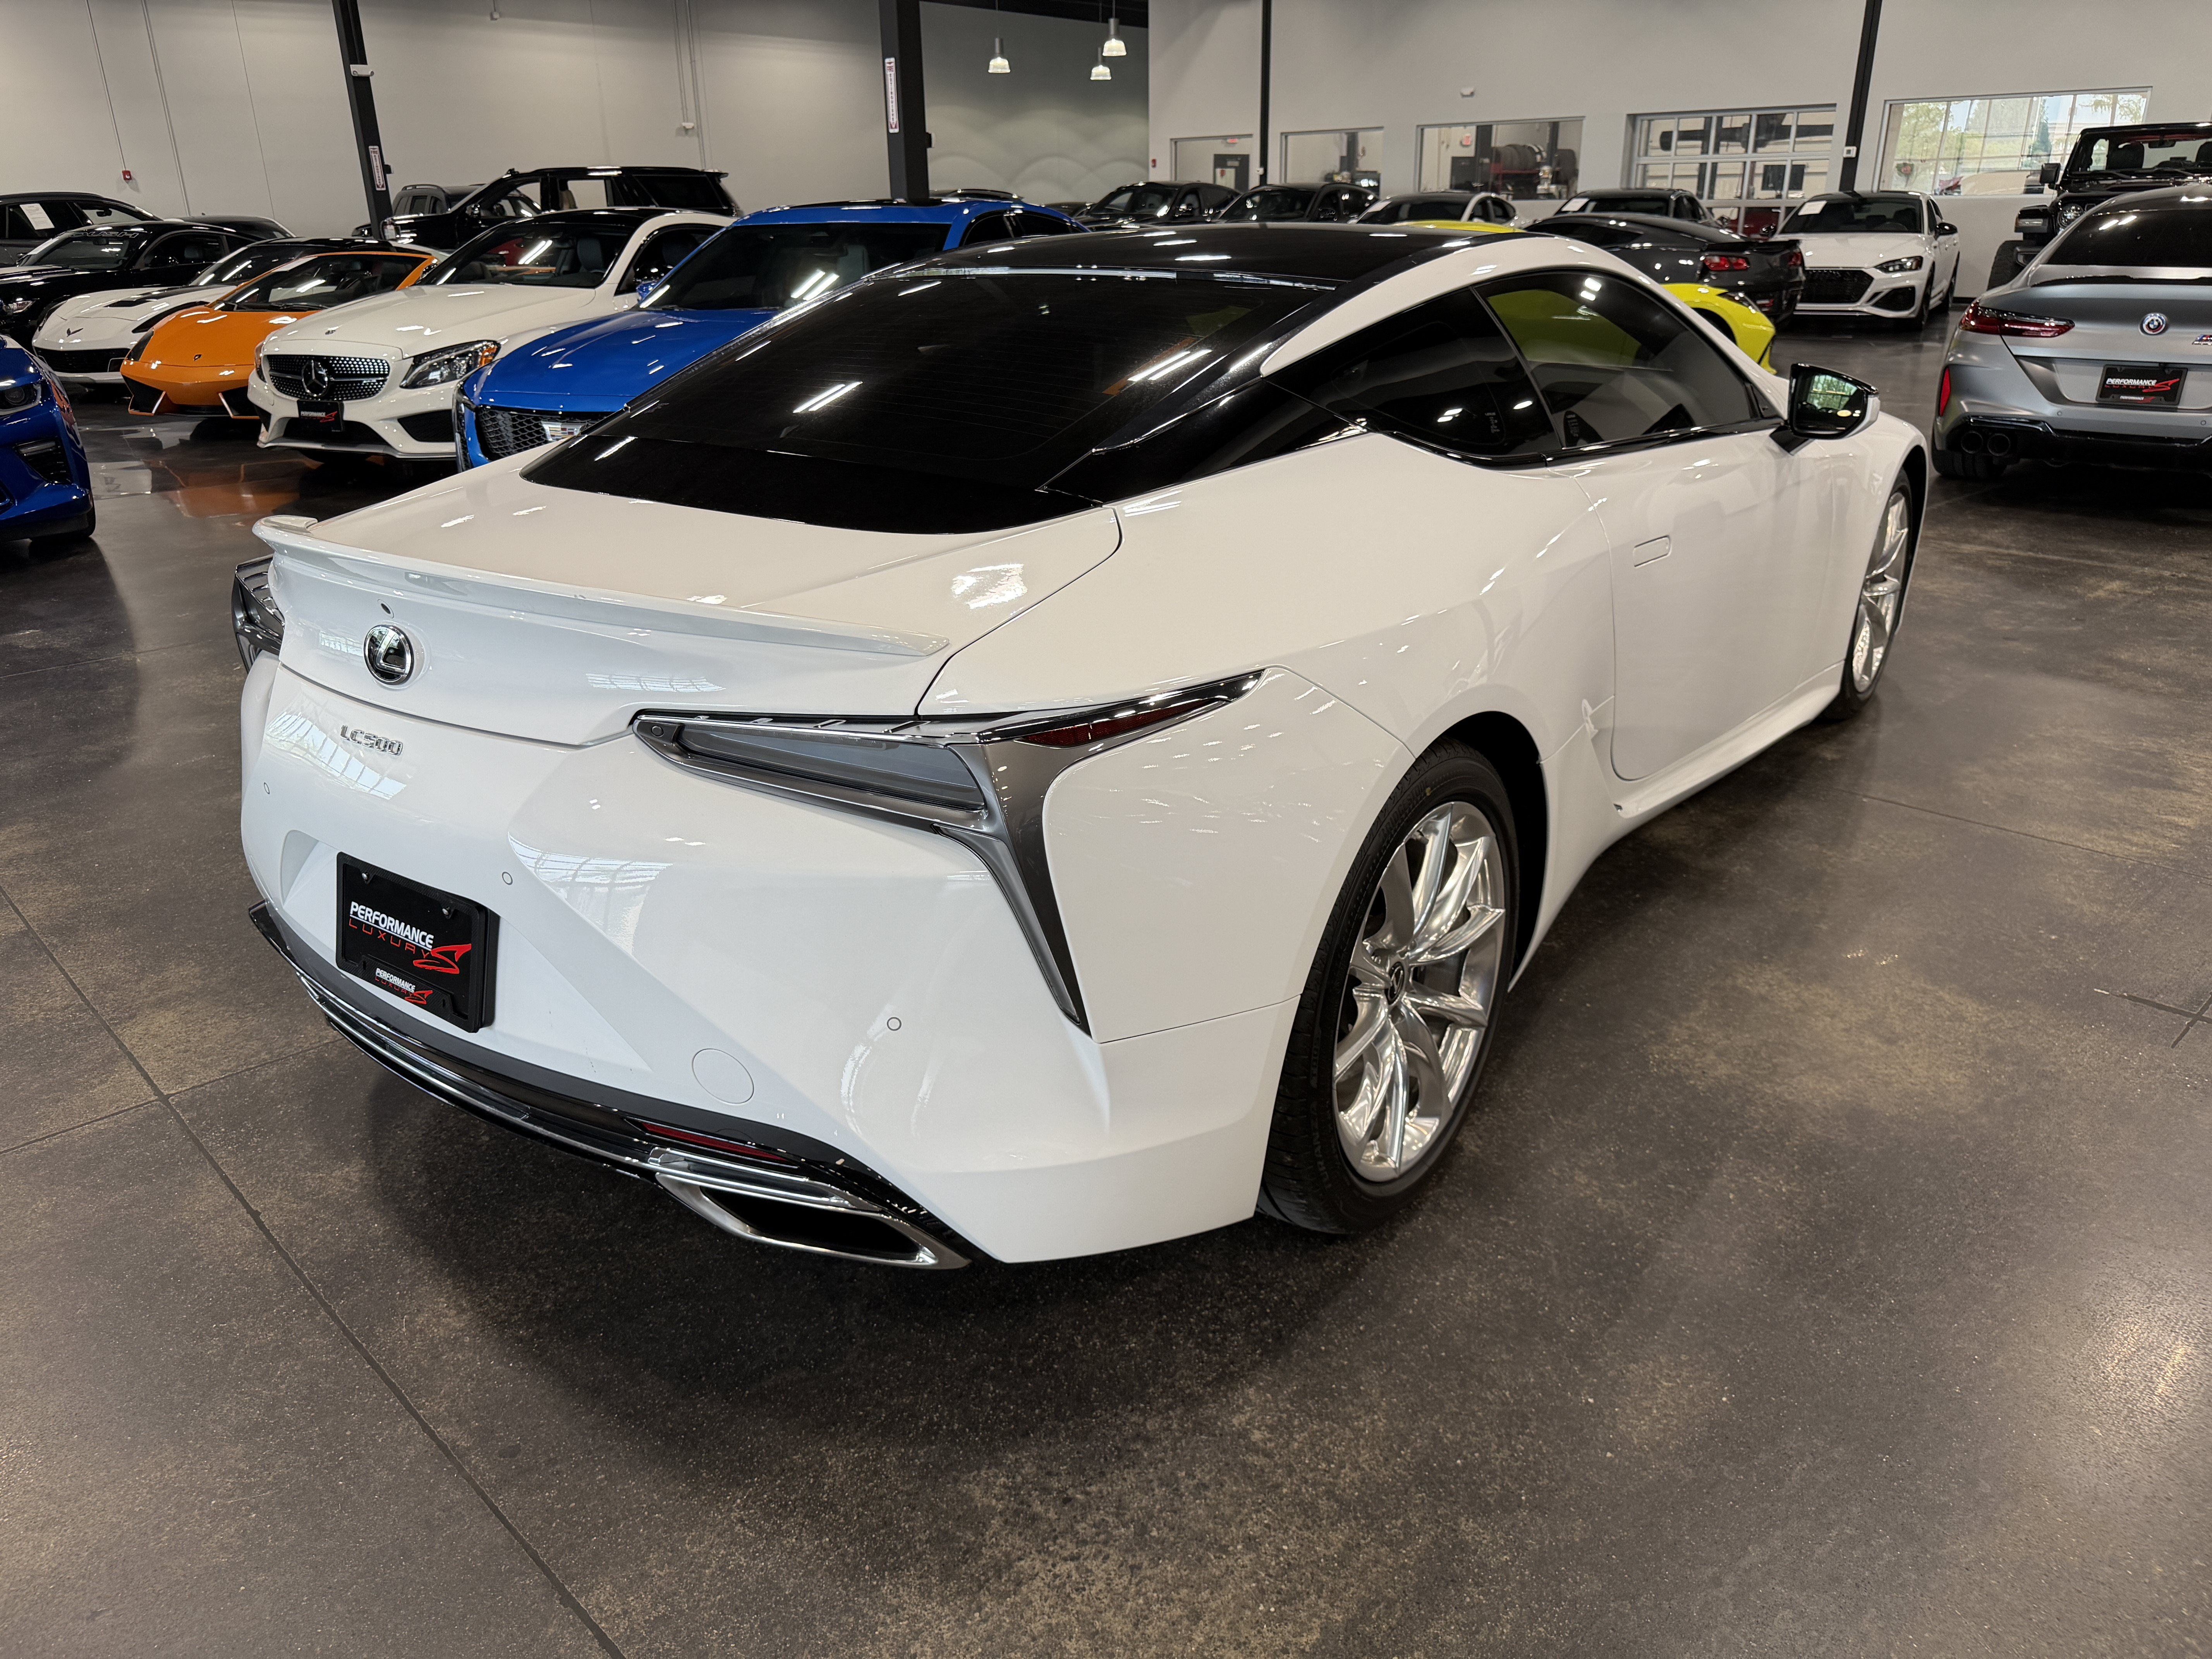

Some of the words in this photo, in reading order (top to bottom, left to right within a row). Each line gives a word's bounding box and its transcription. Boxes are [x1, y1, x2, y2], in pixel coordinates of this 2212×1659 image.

[340, 725, 403, 756] LC500
[349, 918, 429, 958] LUXURY
[350, 901, 434, 949] PERFORMANCE
[376, 968, 416, 992] PERFORMANCE
